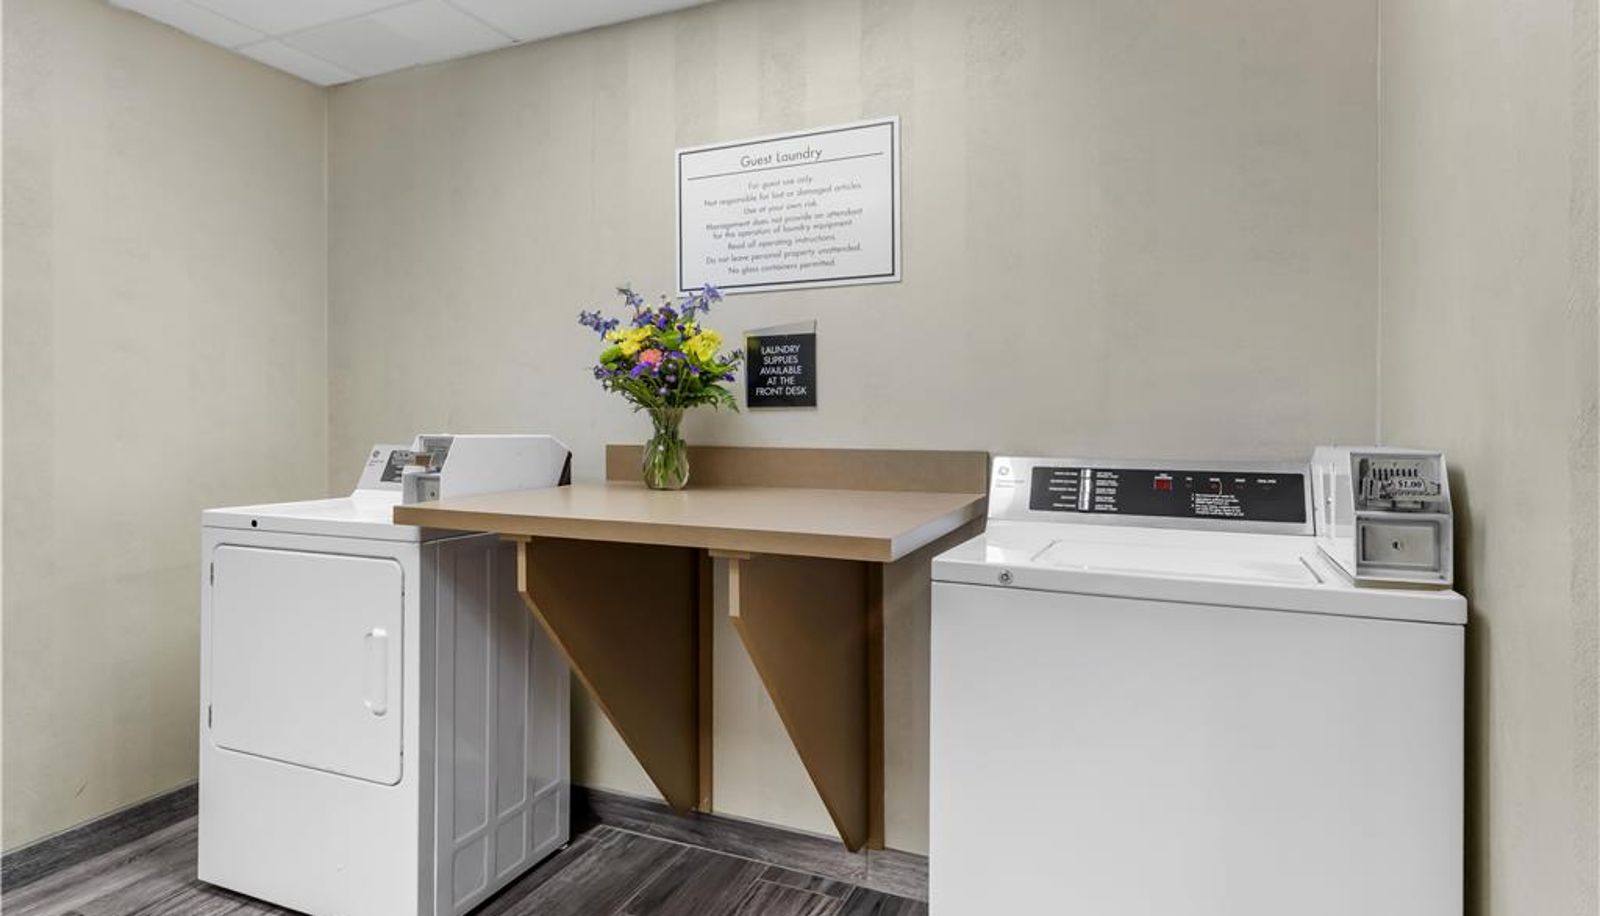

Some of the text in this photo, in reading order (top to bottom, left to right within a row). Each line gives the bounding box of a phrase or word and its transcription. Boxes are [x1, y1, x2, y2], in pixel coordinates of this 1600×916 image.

[740, 144, 822, 168] Guest Laundry
[762, 178, 780, 191] guest
[783, 178, 794, 186] use
[704, 199, 718, 207] Not
[719, 194, 757, 207] responsible
[759, 192, 769, 201] for
[797, 183, 832, 196] damaged
[743, 207, 757, 215] Use
[768, 204, 783, 214] your
[786, 202, 801, 210] own
[706, 219, 751, 232] Management
[752, 217, 769, 226] does
[771, 215, 783, 224] not
[784, 211, 811, 224] provide
[826, 207, 863, 218] attendant
[713, 230, 722, 239] for
[725, 227, 736, 237] the
[738, 227, 771, 238] operation
[773, 224, 780, 233] of
[783, 221, 811, 233] laundry
[727, 241, 745, 250] Read
[747, 239, 756, 248] all
[758, 238, 793, 249] operating
[706, 256, 717, 264] Do
[731, 251, 749, 261] leave
[751, 249, 782, 263] personal
[784, 248, 816, 260] property
[727, 266, 740, 274] No
[742, 264, 759, 276] glass
[760, 263, 798, 273] containers
[761, 344, 800, 355] LAUNDRY
[763, 355, 799, 365] SUPPLIES
[759, 365, 803, 375] AVAILABLE
[767, 376, 795, 386] AT THE
[755, 386, 807, 396] FRONT DESK
